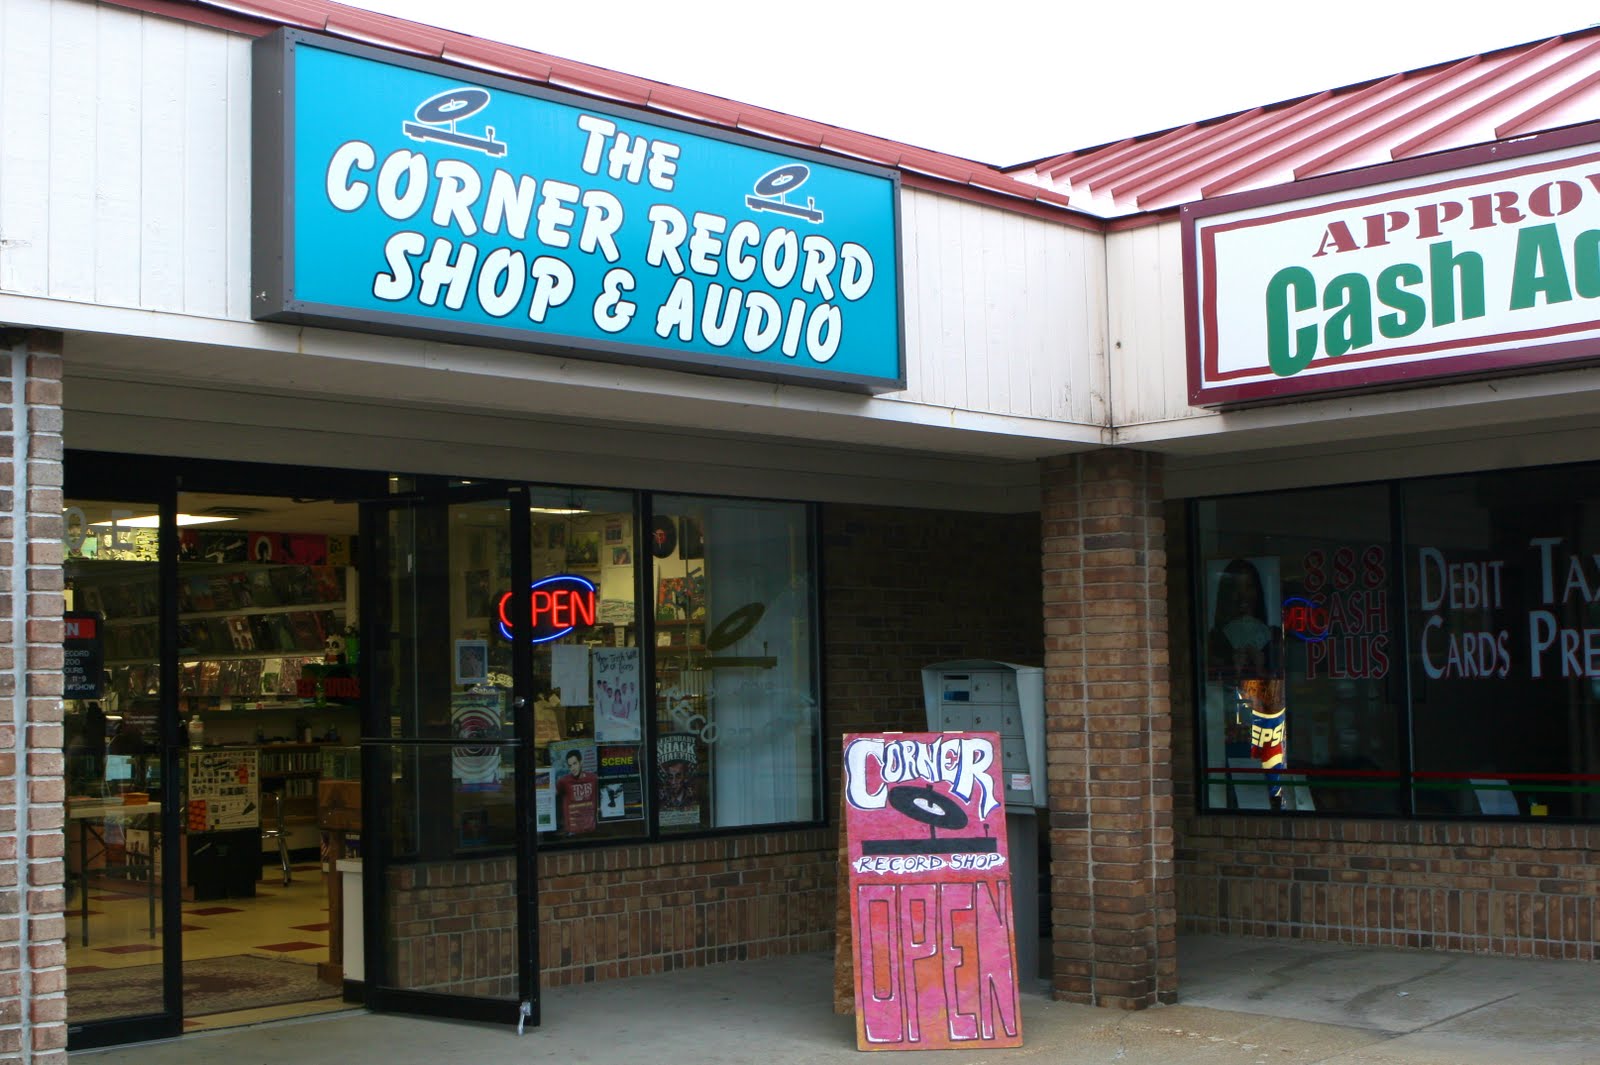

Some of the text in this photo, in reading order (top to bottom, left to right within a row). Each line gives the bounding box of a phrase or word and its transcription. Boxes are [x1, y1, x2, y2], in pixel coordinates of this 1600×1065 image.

[578, 114, 681, 192] THE
[325, 140, 875, 303] CORNER RECORD
[373, 231, 843, 364] SHOP & AUDIO
[1265, 240, 1486, 377] Cash
[1306, 591, 1389, 637] CASH
[1306, 634, 1390, 680] PLUS
[601, 756, 634, 767] SCENE
[656, 741, 697, 756] SHACK
[845, 735, 1002, 822] CORNER
[858, 853, 1002, 873] RECORD SHOP
[857, 880, 1018, 1043] OPEN
